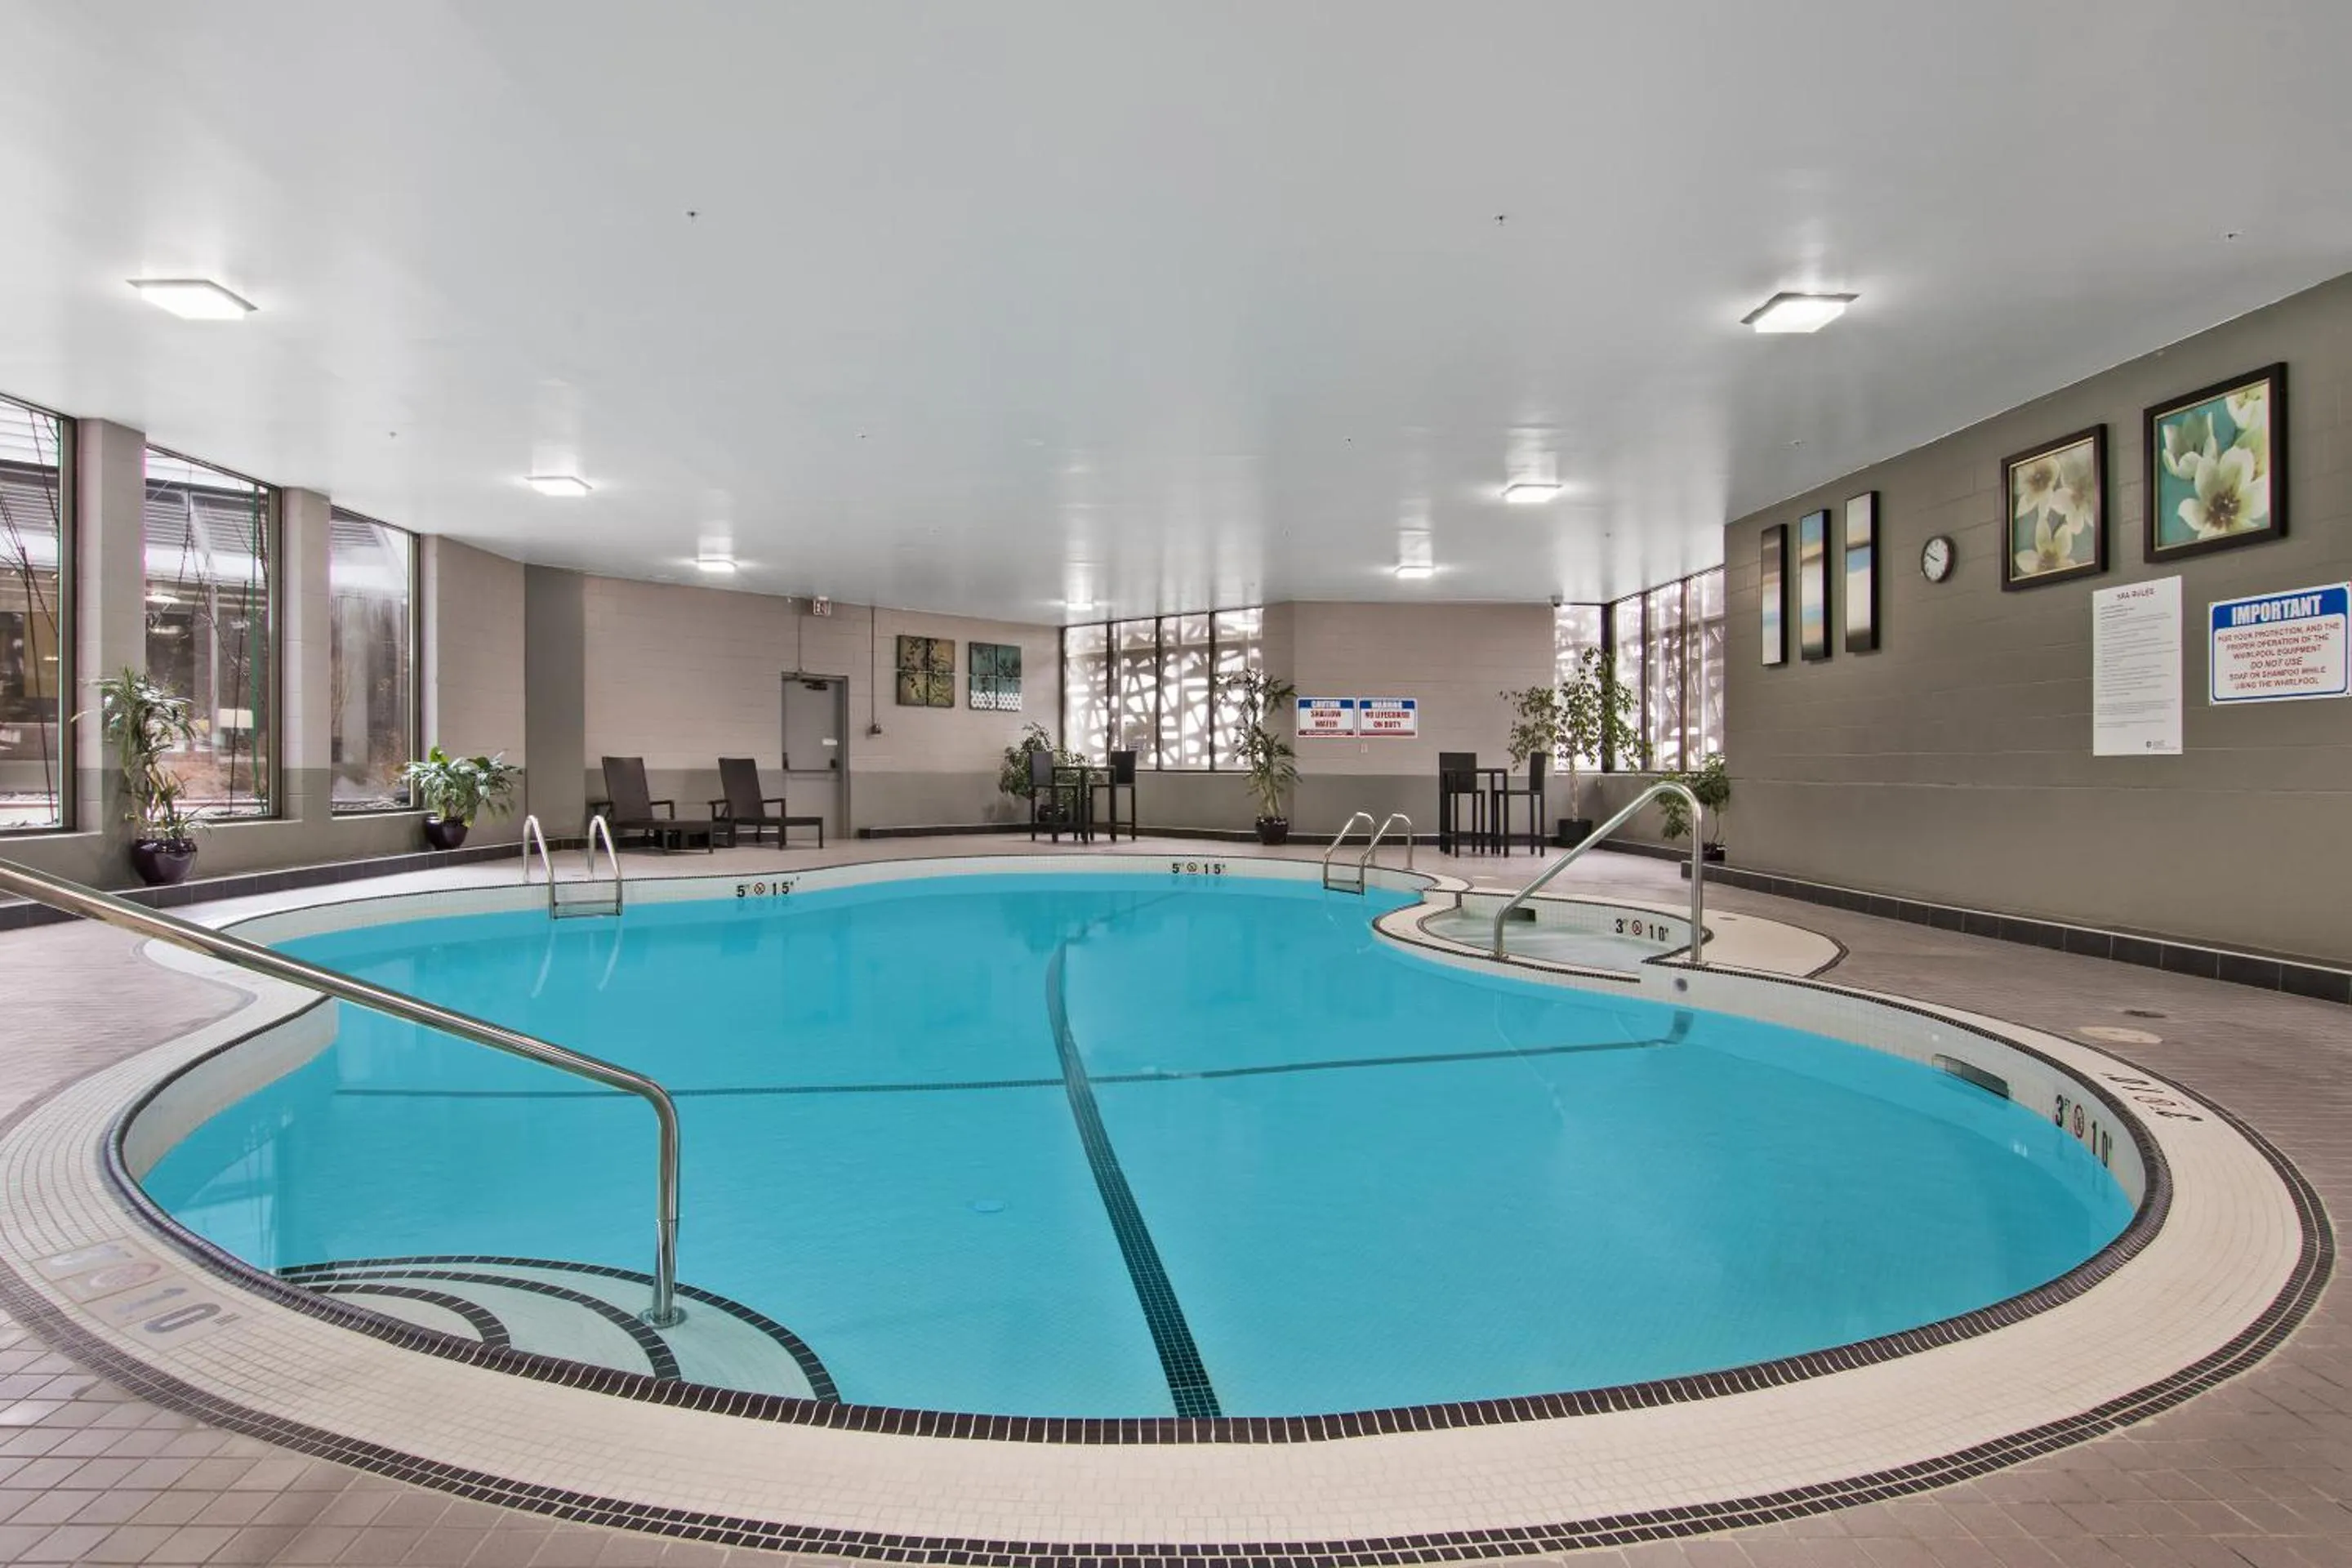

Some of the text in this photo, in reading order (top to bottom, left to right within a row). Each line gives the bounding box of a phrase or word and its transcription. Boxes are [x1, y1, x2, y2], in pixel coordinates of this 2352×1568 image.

[2232, 594, 2322, 626] IMPORTANT
[2234, 632, 2252, 641] YOUR
[2306, 623, 2323, 632] AND
[2324, 621, 2340, 630] THE
[2226, 642, 2255, 652] PROPER
[2256, 638, 2300, 648] OPERATION
[2314, 633, 2329, 641] THE
[2234, 644, 2322, 660] WHIRLPOOL EQUIPMENT
[2250, 656, 2302, 670] DO NOT USE
[2229, 672, 2247, 680] SOAP
[2261, 668, 2299, 679] SHAMPOO
[2234, 677, 2319, 690] USING THE WHIRLPOOL
